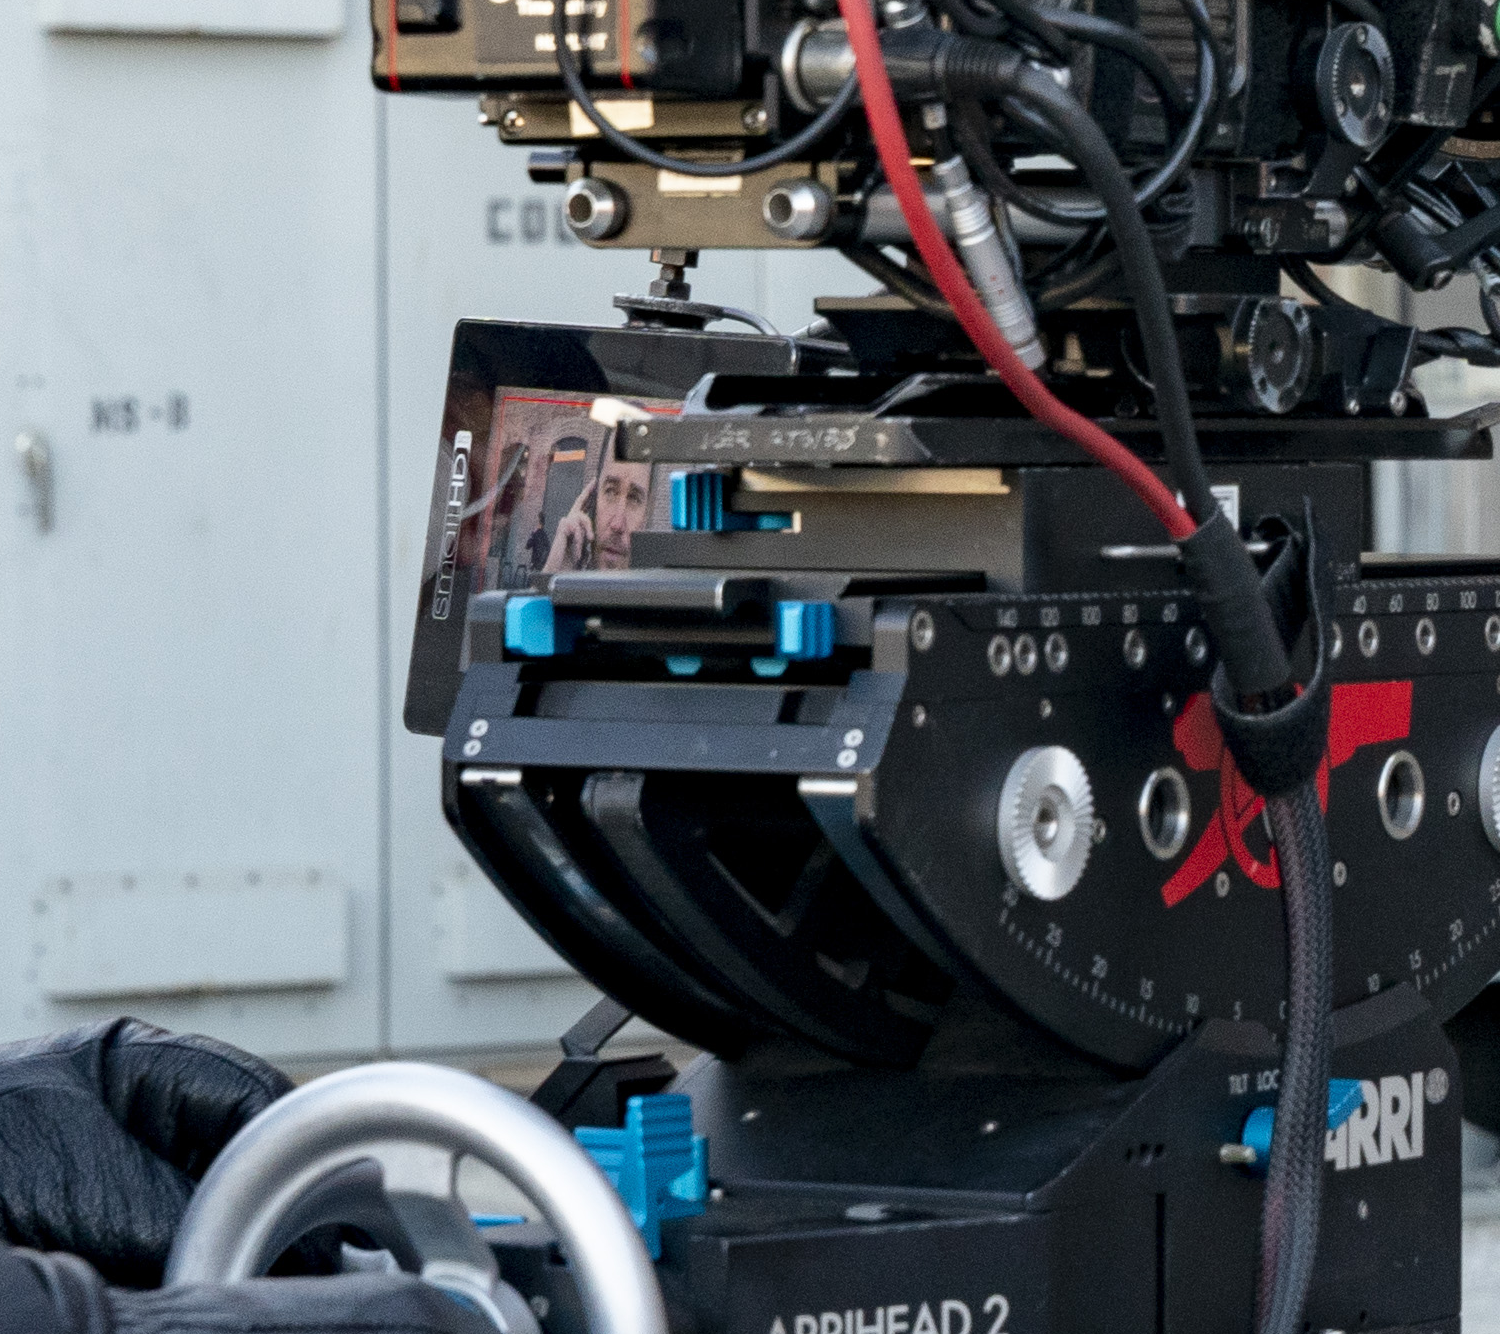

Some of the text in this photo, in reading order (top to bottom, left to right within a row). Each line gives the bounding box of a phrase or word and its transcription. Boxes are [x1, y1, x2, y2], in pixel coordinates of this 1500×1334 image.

[1459, 590, 1478, 610] 100
[1081, 604, 1101, 626] 100
[1256, 1068, 1281, 1093] LOC
